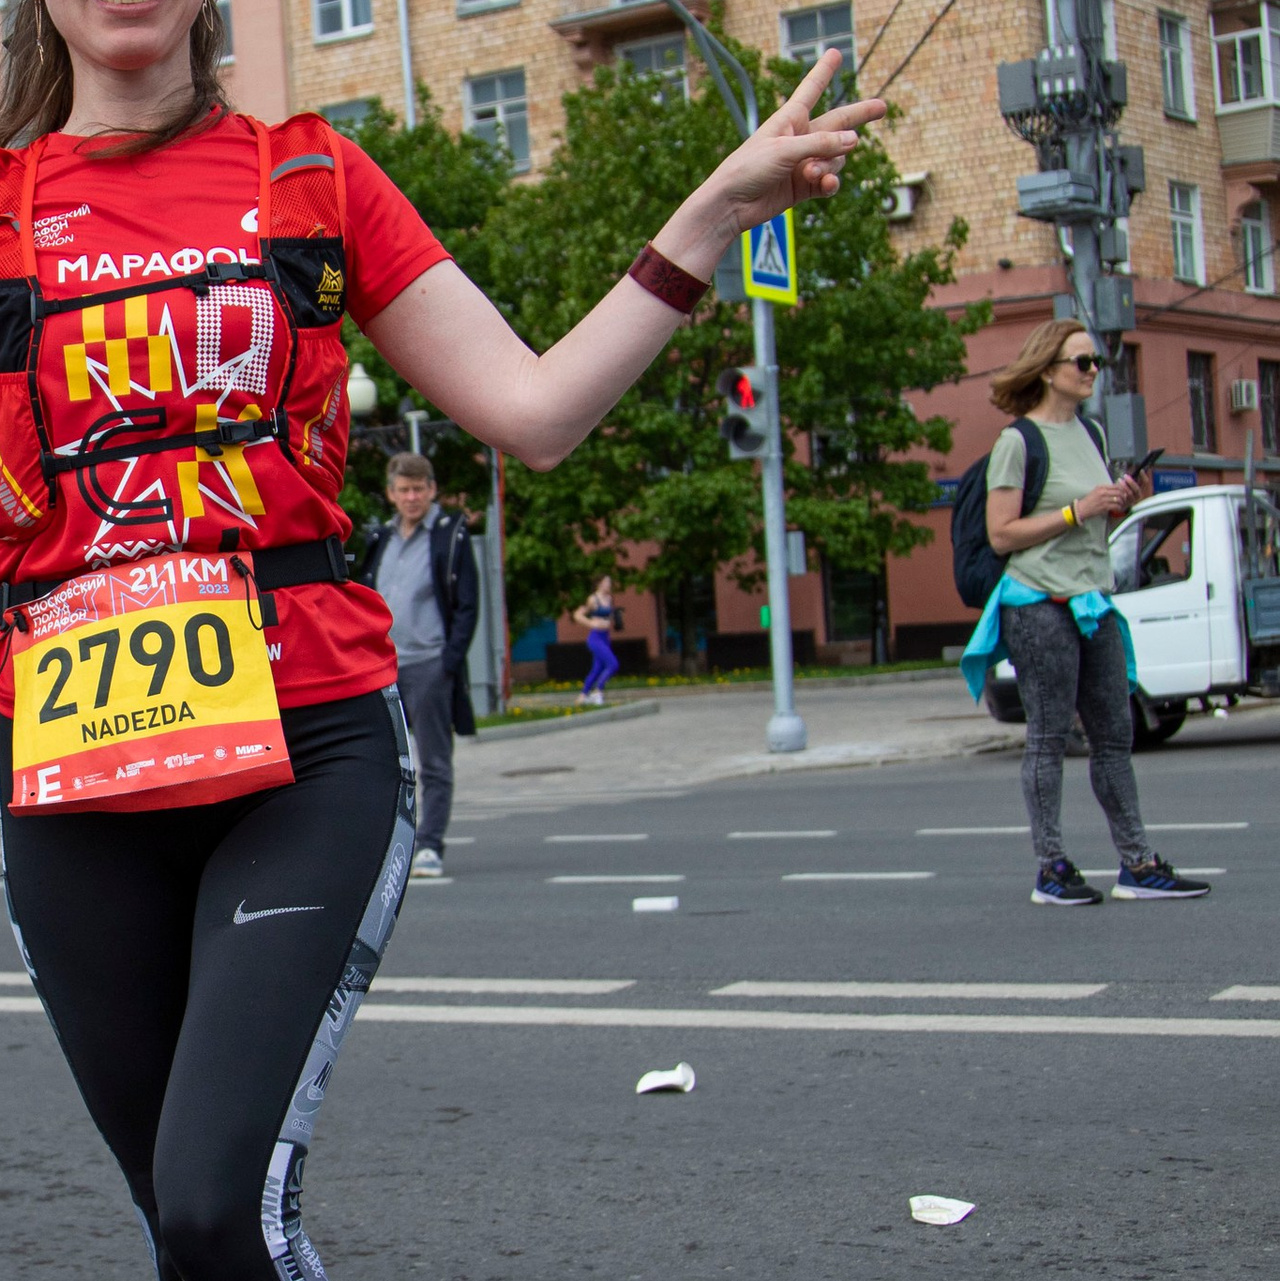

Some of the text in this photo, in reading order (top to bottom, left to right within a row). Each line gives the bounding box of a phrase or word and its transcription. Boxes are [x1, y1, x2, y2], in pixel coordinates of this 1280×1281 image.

[32, 203, 91, 230] КОВСКИЙ
[28, 574, 107, 617] МОСКОВСКИЙ
[199, 584, 230, 595] 2023
[33, 606, 62, 628] ПОЛУ
[33, 610, 88, 639] МАРАФОН
[37, 612, 235, 725] 2790
[81, 701, 196, 744] NADEZDA
[235, 744, 263, 756] МИР
[37, 765, 63, 805] E
